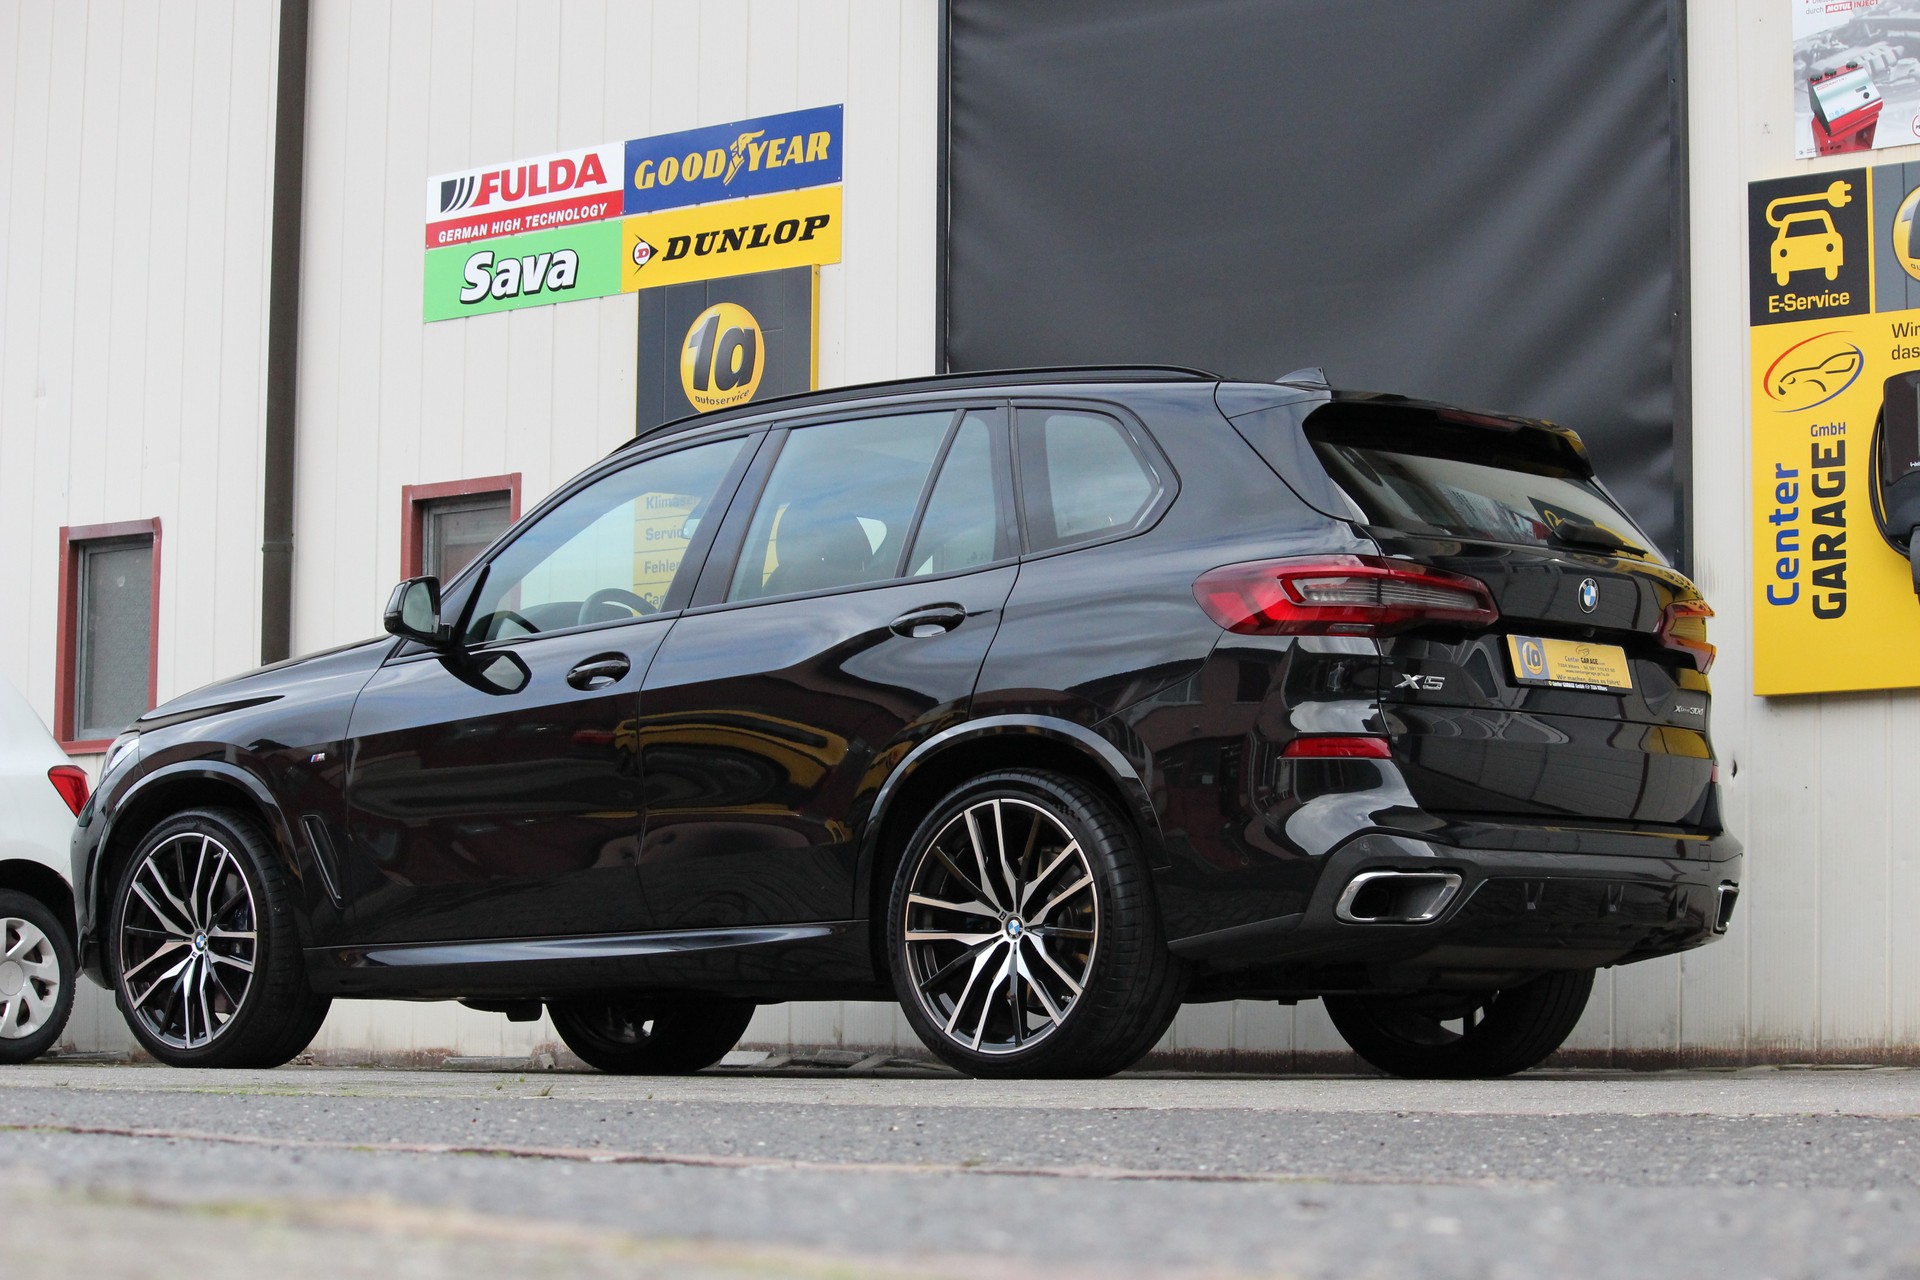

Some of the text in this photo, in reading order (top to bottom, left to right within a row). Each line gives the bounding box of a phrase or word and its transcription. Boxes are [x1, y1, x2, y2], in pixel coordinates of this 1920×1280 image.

[1826, 2, 1851, 13] MOTUL
[469, 153, 607, 208] FULDA
[438, 203, 608, 243] GERMAN HIGH TECHNOLOGY
[662, 214, 830, 261] DUNLOP
[459, 248, 579, 304] Sava
[1768, 289, 1850, 313] E-Service
[688, 313, 756, 391] 1a
[694, 389, 750, 405] autoservice
[1810, 421, 1846, 437] GmbH
[1766, 462, 1800, 606] Center
[1811, 439, 1847, 619] GARAGE
[1394, 673, 1446, 691] X5
